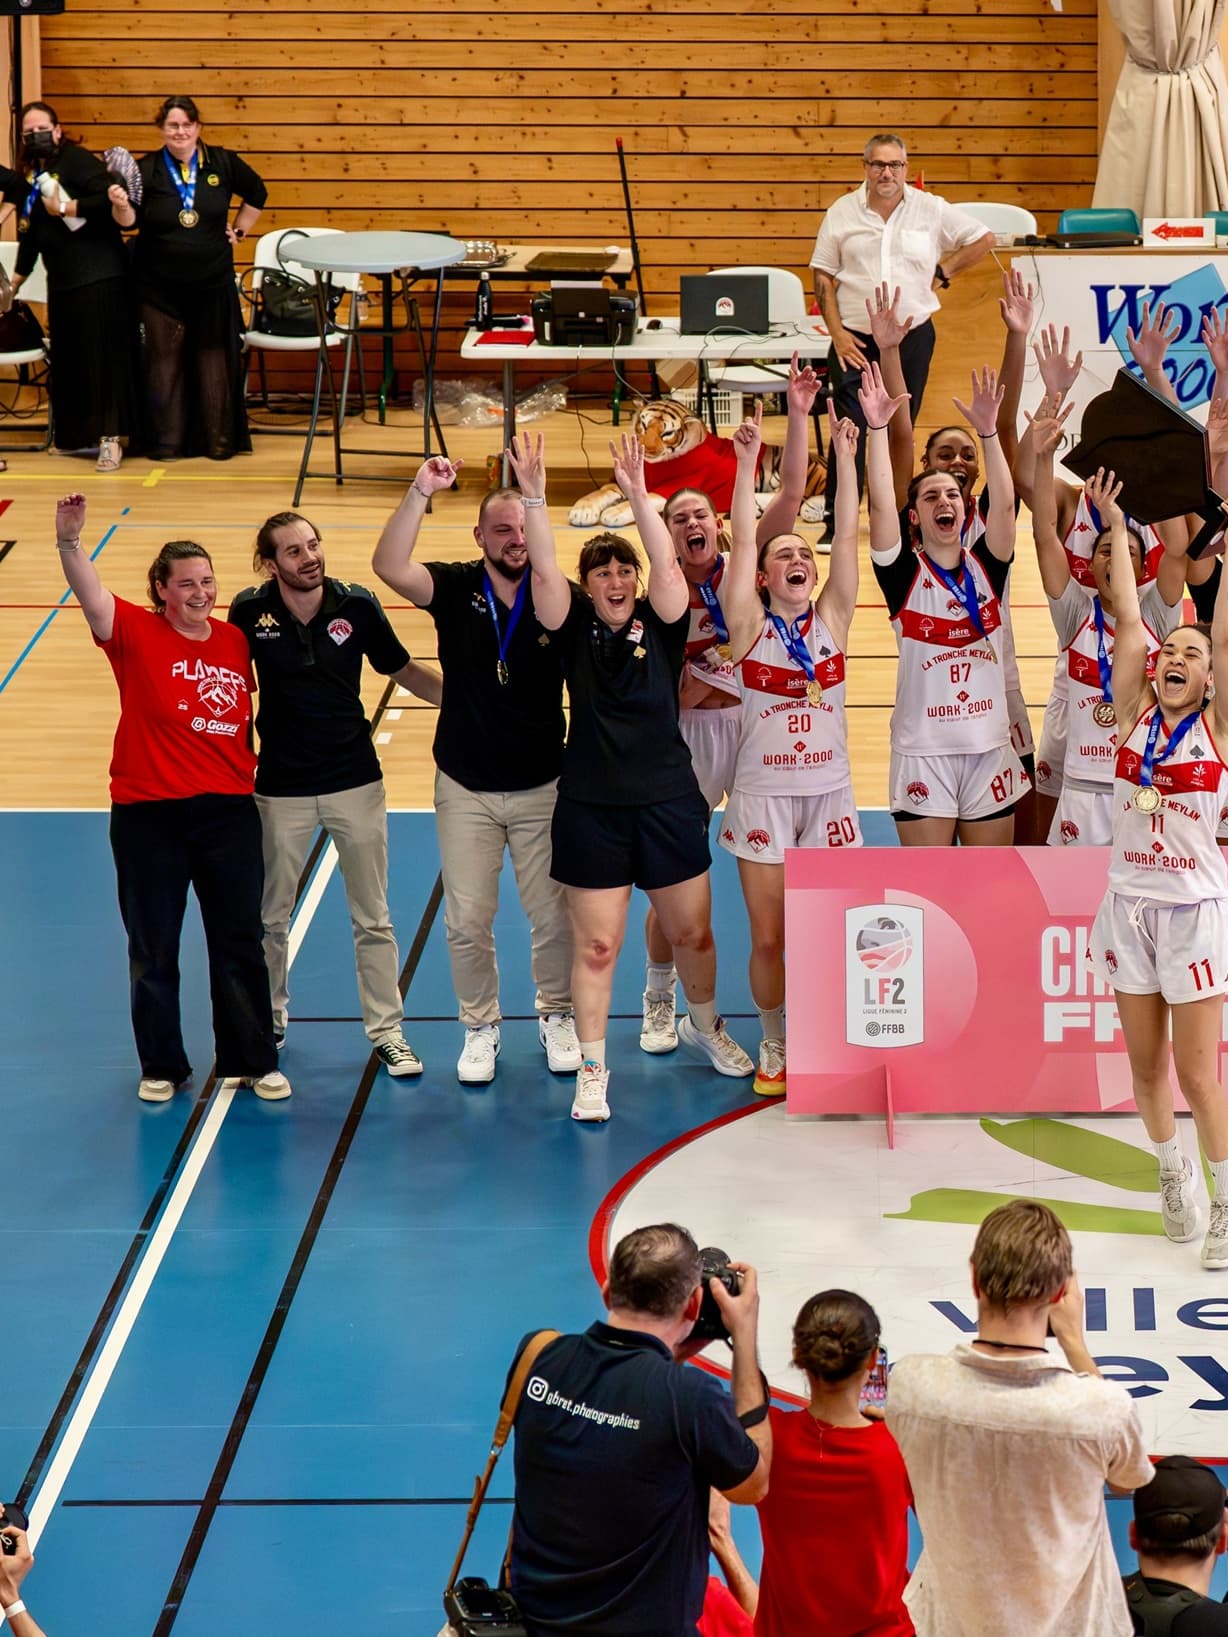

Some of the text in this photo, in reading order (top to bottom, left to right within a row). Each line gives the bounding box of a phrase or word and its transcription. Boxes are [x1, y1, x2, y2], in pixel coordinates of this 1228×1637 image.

[948, 628, 969, 637] isère
[921, 660, 933, 671] LA
[932, 649, 968, 664] TRONCHE
[949, 662, 971, 684] 87
[759, 708, 771, 720] LA
[772, 700, 807, 714] TRONCHE
[927, 705, 961, 718] WORK
[967, 699, 993, 714] 2000
[207, 719, 240, 733] Gozzi
[788, 714, 812, 734] 20
[763, 749, 833, 765] WORK 2000
[1080, 745, 1112, 758] WORK
[990, 768, 1013, 803] 87
[1153, 773, 1172, 784] sère
[1167, 800, 1201, 821] MEYLAN
[827, 817, 856, 847] 20
[1151, 813, 1165, 834] 11
[1123, 850, 1196, 870] WORK 2000
[1188, 958, 1215, 991] 11
[864, 978, 906, 1005] LF2
[881, 1023, 905, 1034] FFBB
